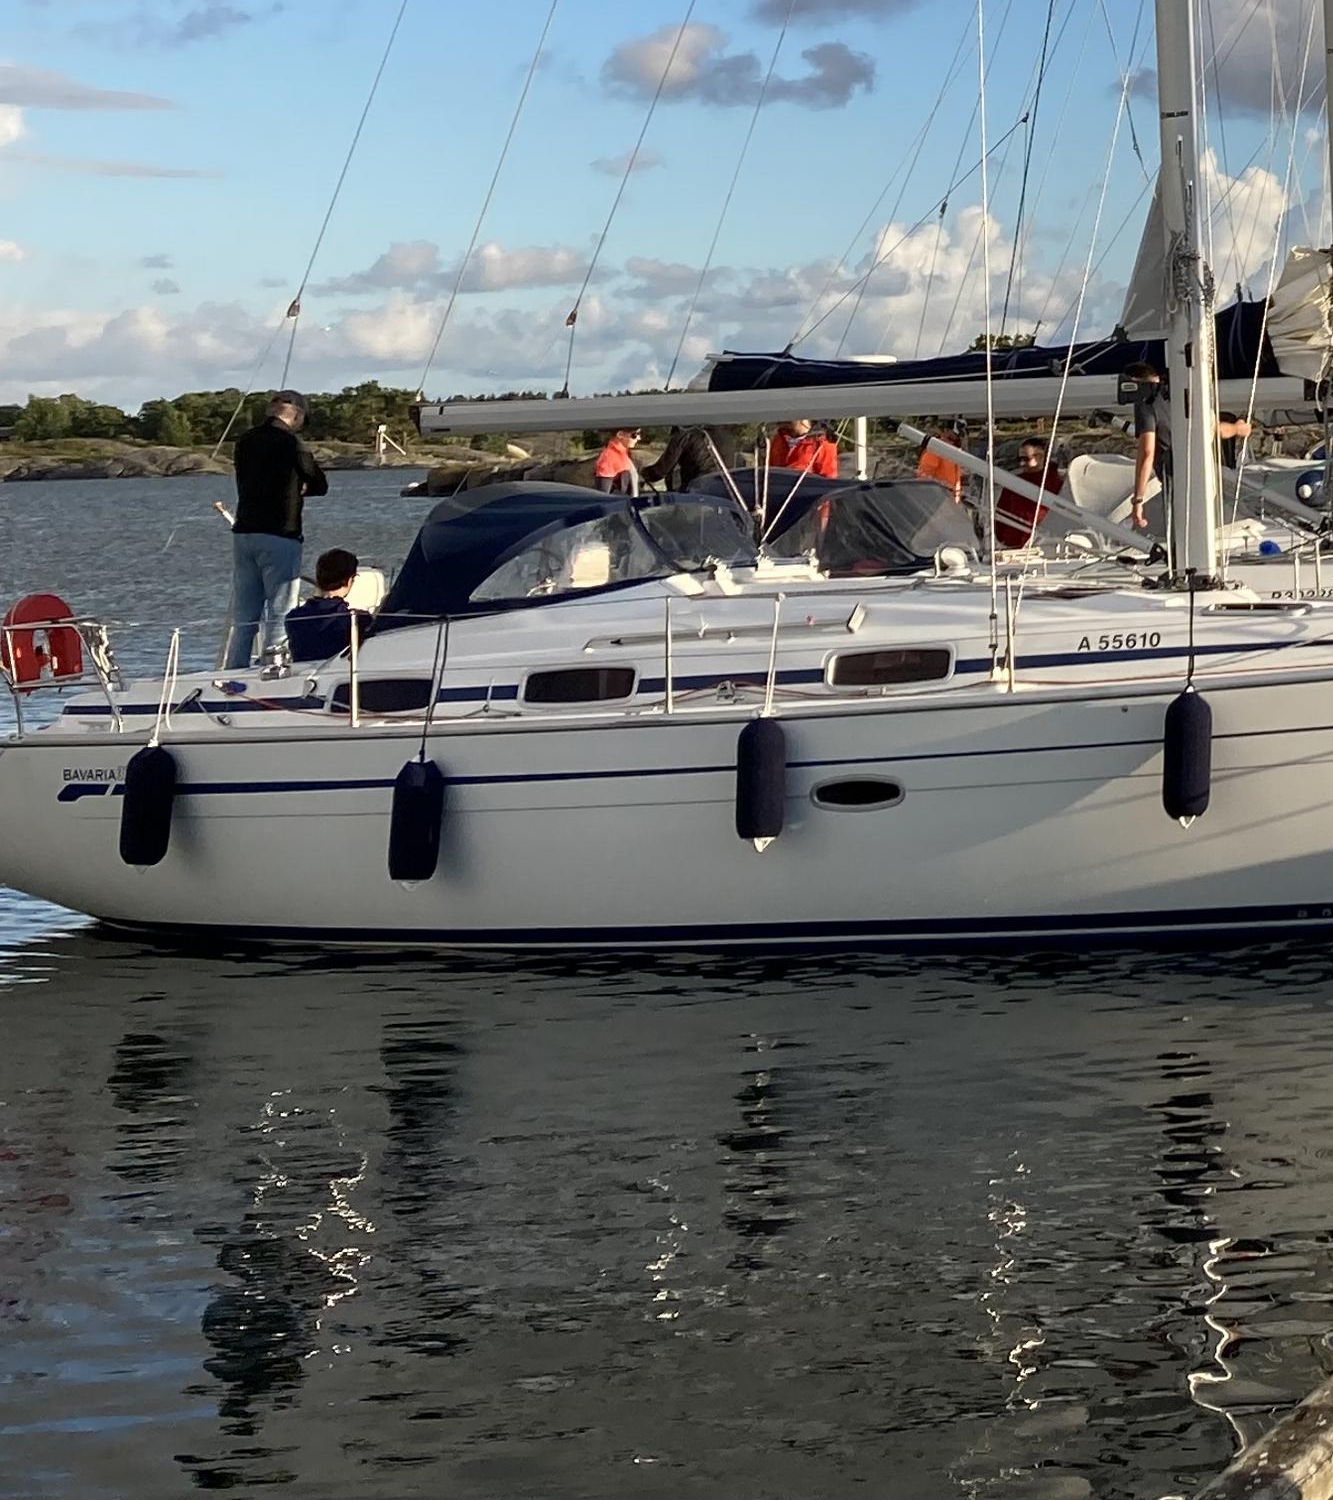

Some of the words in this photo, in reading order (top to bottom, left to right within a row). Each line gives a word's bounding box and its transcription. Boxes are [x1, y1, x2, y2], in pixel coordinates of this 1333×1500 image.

[1077, 636, 1091, 651] A
[1098, 632, 1162, 650] 55610
[63, 768, 116, 781] BAVARIA
